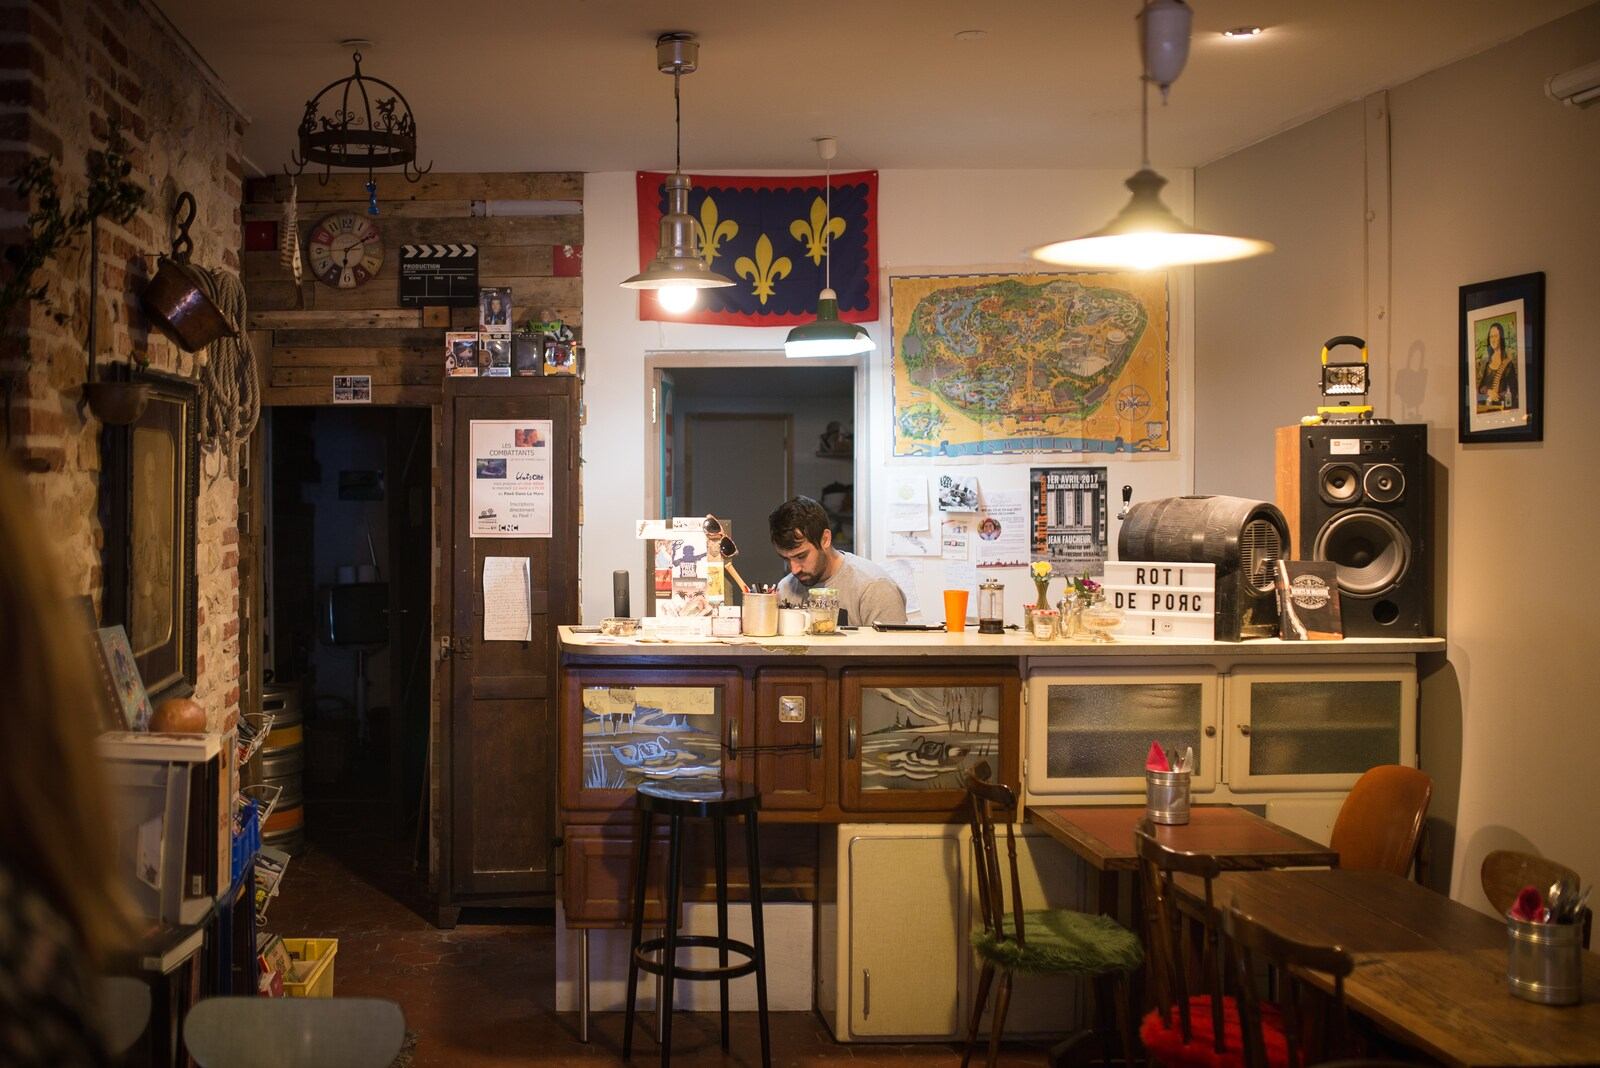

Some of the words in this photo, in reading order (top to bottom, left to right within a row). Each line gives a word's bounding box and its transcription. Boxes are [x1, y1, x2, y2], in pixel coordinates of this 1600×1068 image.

[1047, 475, 1059, 484] 1ER
[1060, 474, 1080, 483] AVRIL
[1081, 474, 1099, 483] 2017
[1048, 535, 1061, 544] JEAN
[1062, 534, 1091, 544] FAUCHEUR
[1136, 568, 1183, 586] ROTI
[1115, 592, 1137, 609] DE
[1151, 618, 1156, 635] !
